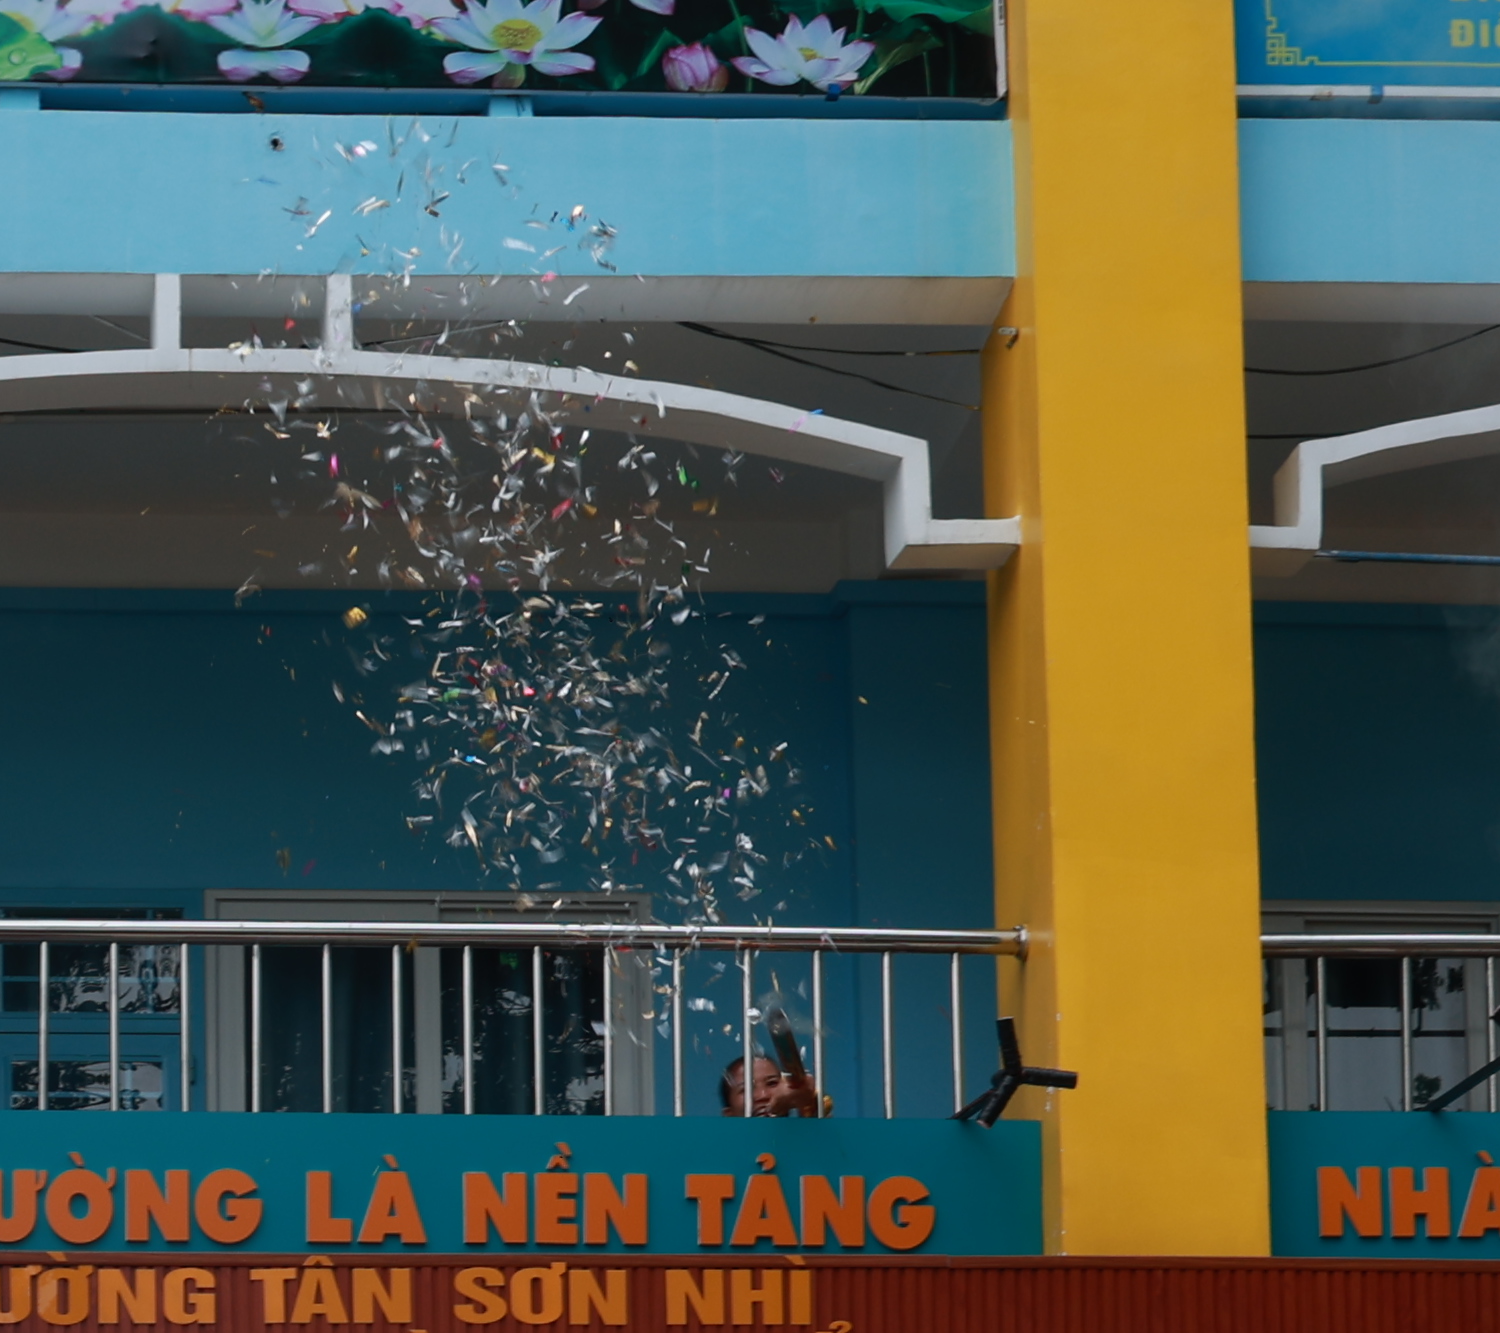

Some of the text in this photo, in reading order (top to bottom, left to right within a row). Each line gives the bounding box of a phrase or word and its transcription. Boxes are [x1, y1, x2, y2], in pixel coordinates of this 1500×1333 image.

[250, 1256, 413, 1326] TÂN
[453, 1260, 628, 1326] SƠN
[664, 1255, 816, 1327] NHÌ
